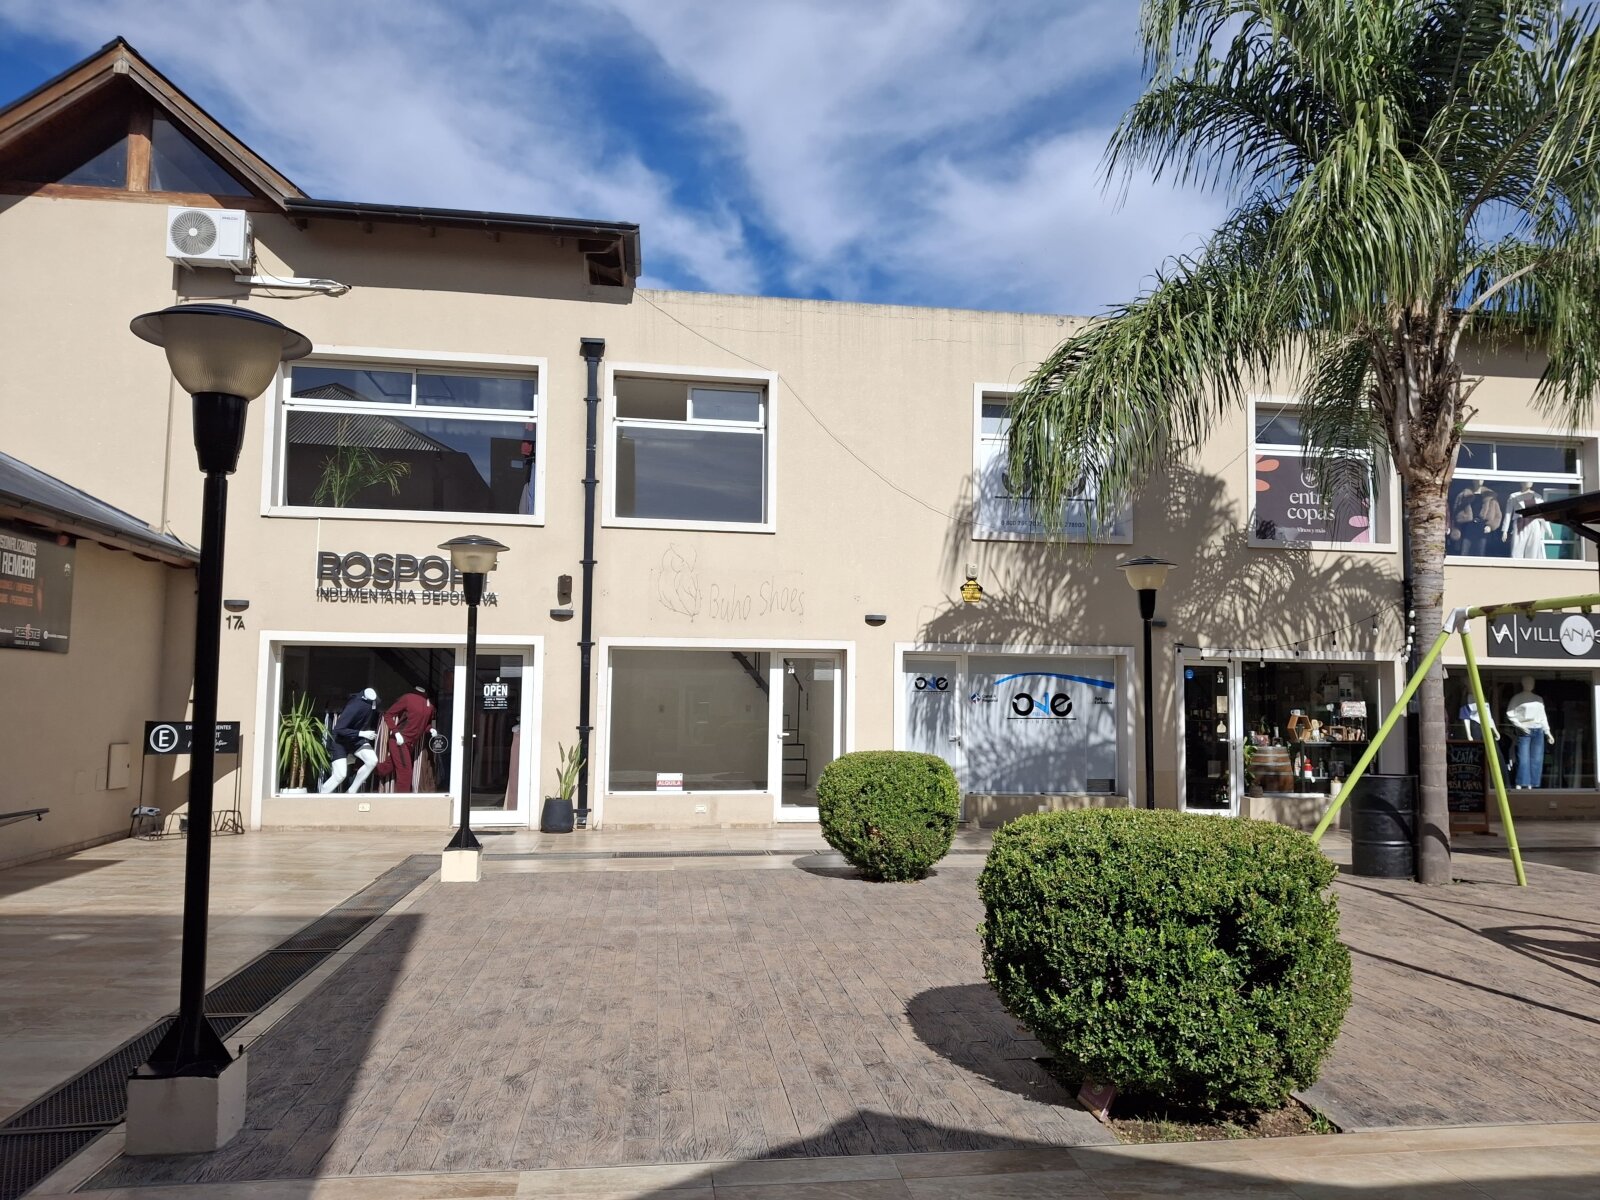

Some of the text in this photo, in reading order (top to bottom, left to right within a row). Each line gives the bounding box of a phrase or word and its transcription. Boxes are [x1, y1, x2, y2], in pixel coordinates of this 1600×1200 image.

[1287, 507, 1335, 525] copas
[2, 552, 36, 579] REMERA
[317, 551, 497, 585] ROSPO
[316, 586, 416, 604] INDUMENTARIA
[759, 577, 804, 617] Shoes
[483, 685, 508, 697] OPEN
[158, 729, 170, 747] E
